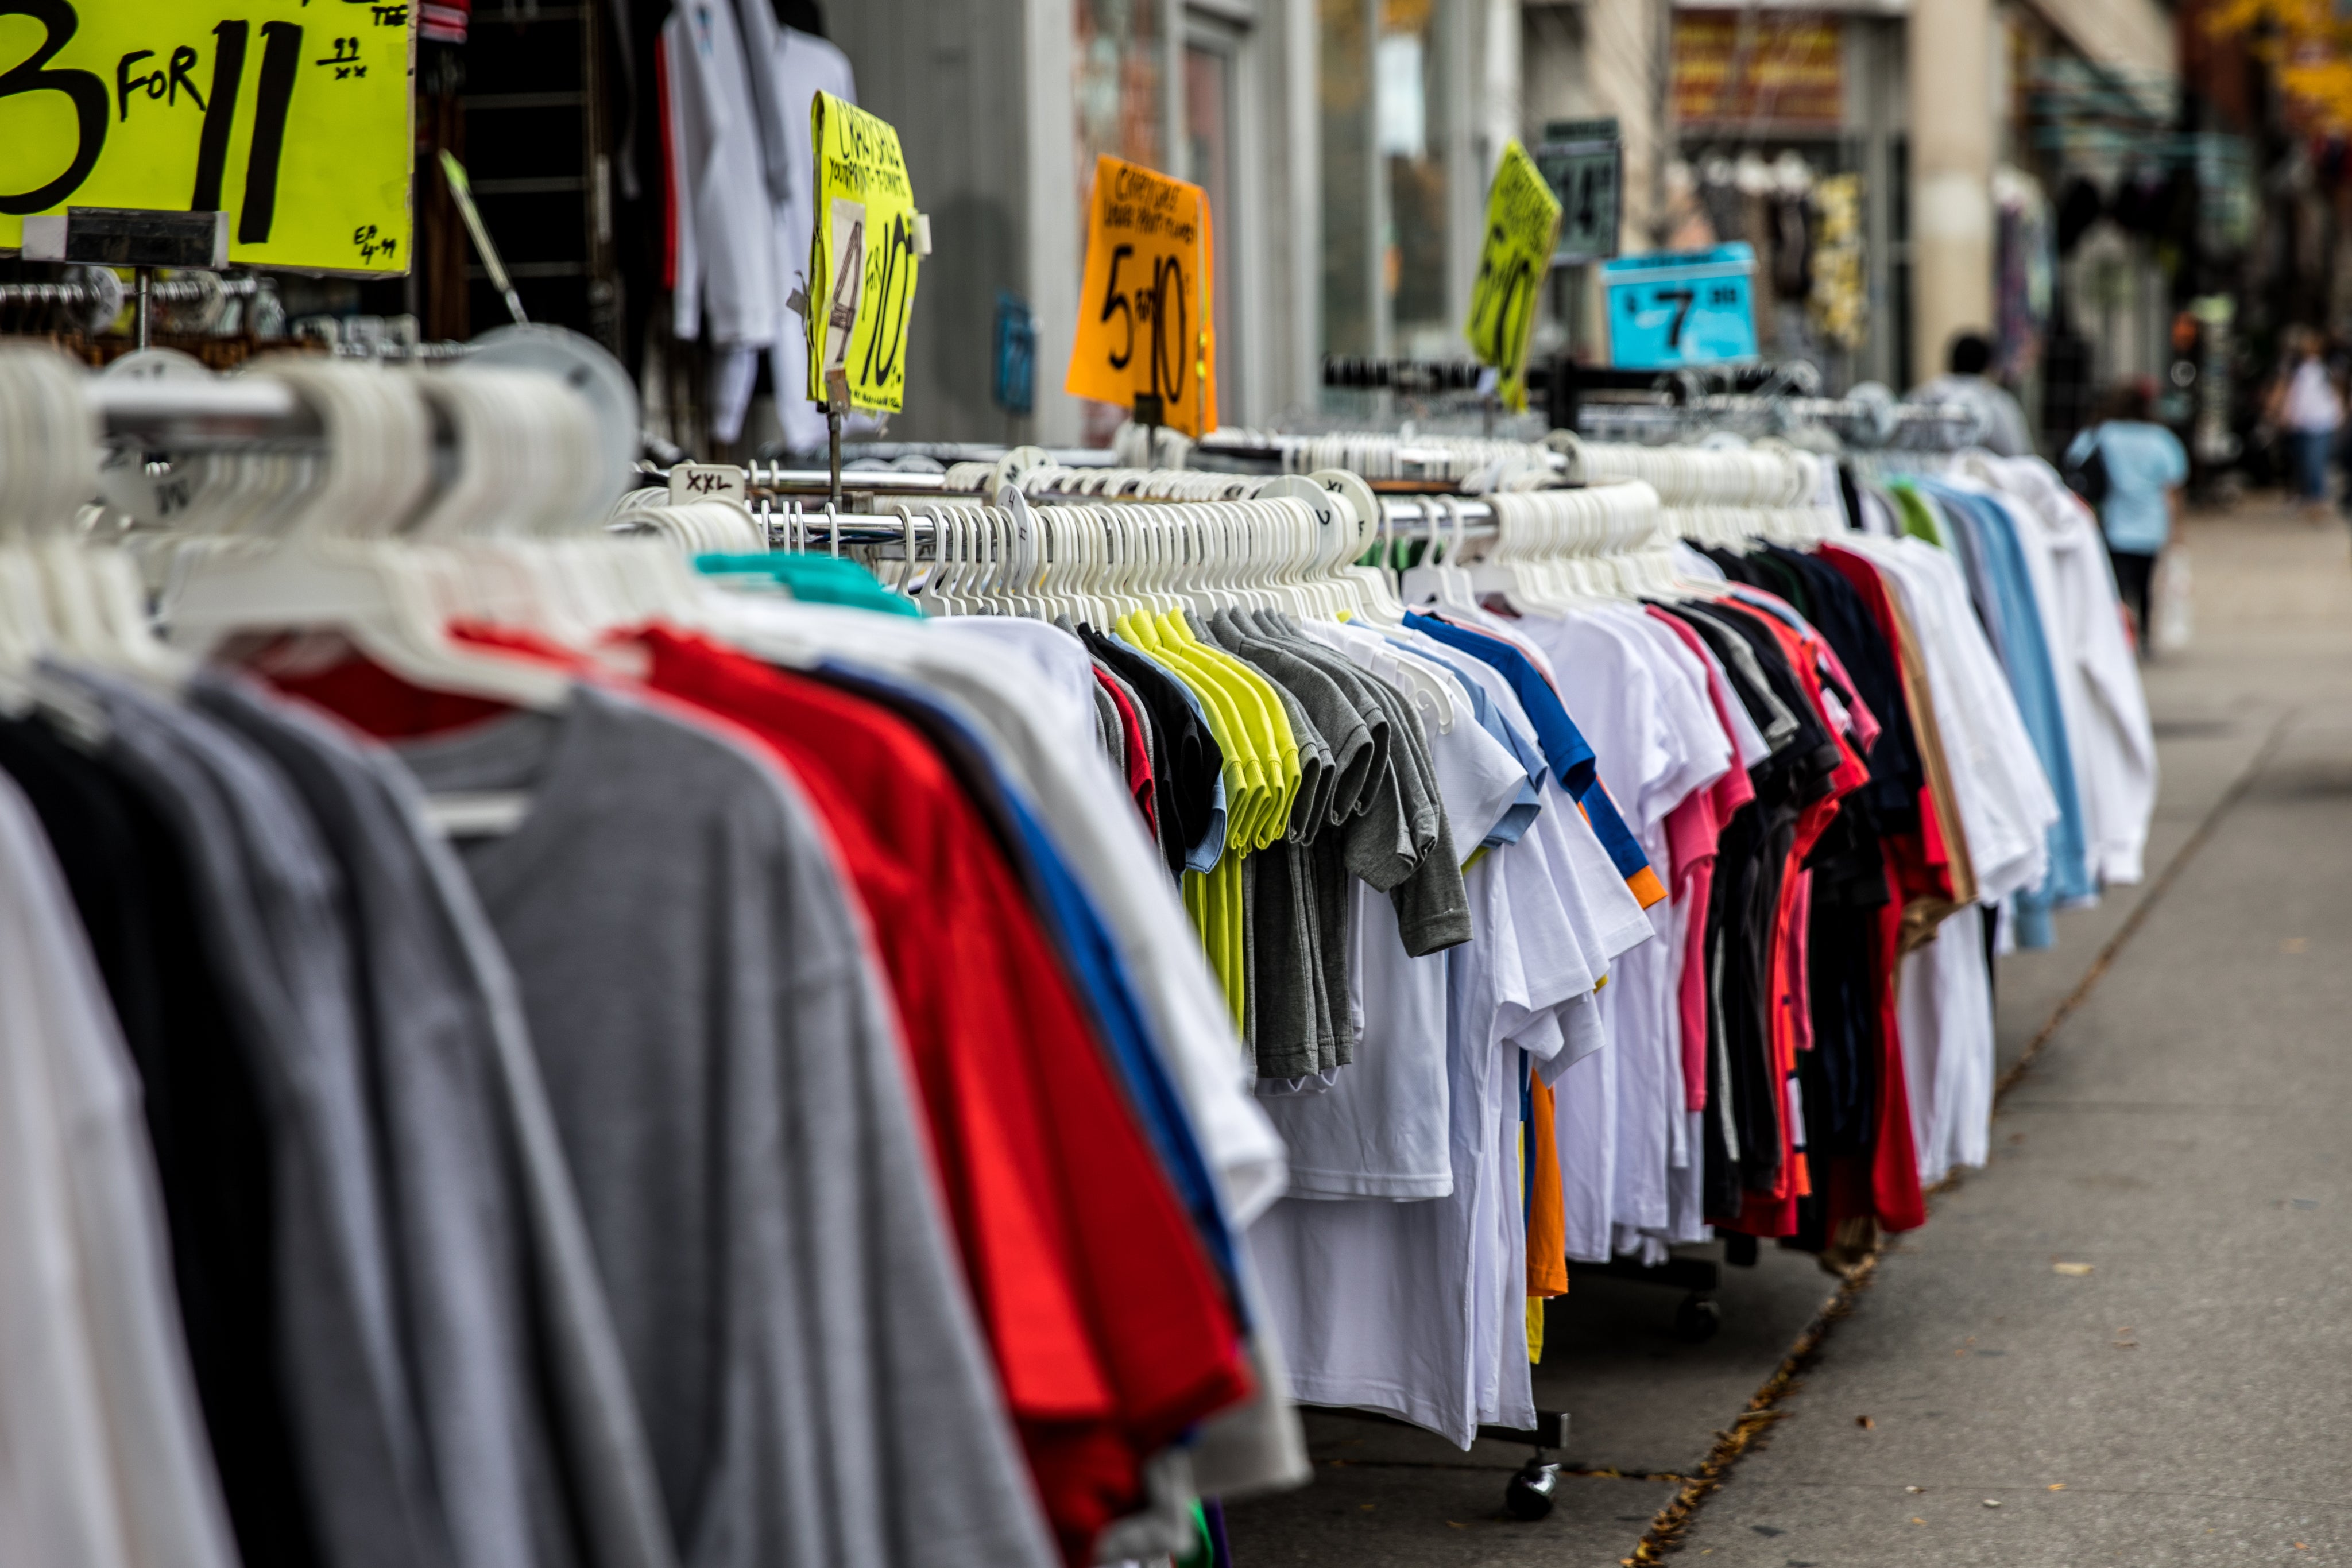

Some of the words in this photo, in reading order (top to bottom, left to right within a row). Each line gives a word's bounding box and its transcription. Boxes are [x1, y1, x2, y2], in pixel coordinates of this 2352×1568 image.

[0, 0, 110, 215] 3
[117, 45, 206, 122] FOR
[190, 20, 303, 244] 11
[828, 220, 862, 363] 4
[860, 212, 910, 388] 10
[1101, 243, 1134, 371] 5
[1151, 254, 1186, 405] 10
[1654, 291, 1694, 348] 7
[687, 470, 732, 494] XXL
